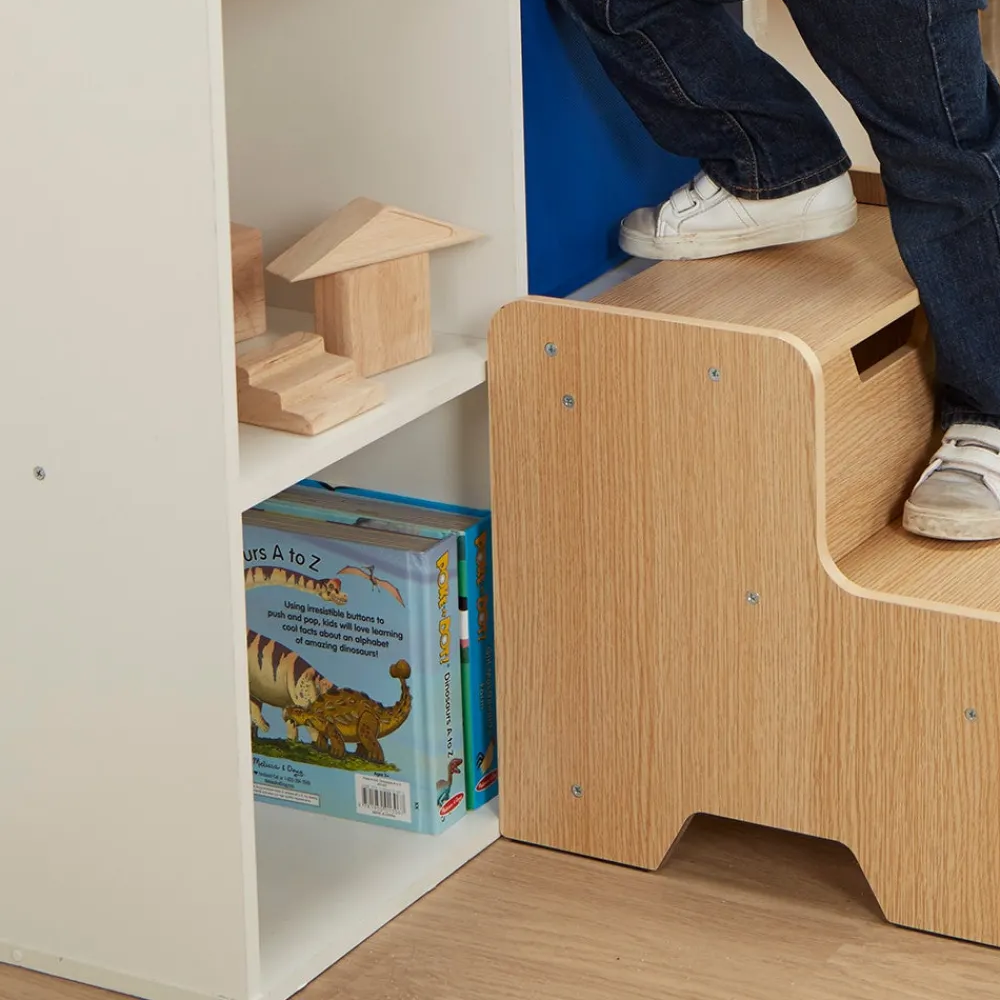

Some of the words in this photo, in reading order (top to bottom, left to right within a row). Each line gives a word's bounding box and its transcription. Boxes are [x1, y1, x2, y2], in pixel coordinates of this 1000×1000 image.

[272, 544, 284, 561] A
[289, 548, 305, 566] to
[308, 554, 321, 573] Z
[283, 600, 306, 613] Using
[307, 604, 345, 619] irresistible
[346, 611, 375, 623] buttons
[376, 616, 385, 625] to
[267, 610, 286, 619] push
[287, 613, 302, 622] and
[303, 616, 321, 626] pop,
[322, 618, 338, 629] kids
[339, 621, 353, 631] will
[353, 623, 370, 634] love
[371, 626, 403, 641] learning
[282, 623, 298, 633] cool
[299, 625, 318, 636] facts
[319, 629, 341, 640] about
[342, 634, 354, 643] an
[354, 635, 389, 648] alphabet
[295, 636, 303, 645] of
[304, 639, 338, 653] amazing
[339, 644, 379, 658] dinosaurs!
[444, 671, 452, 726] Dinosaurs
[447, 737, 453, 749] to
[447, 749, 454, 758] Z
